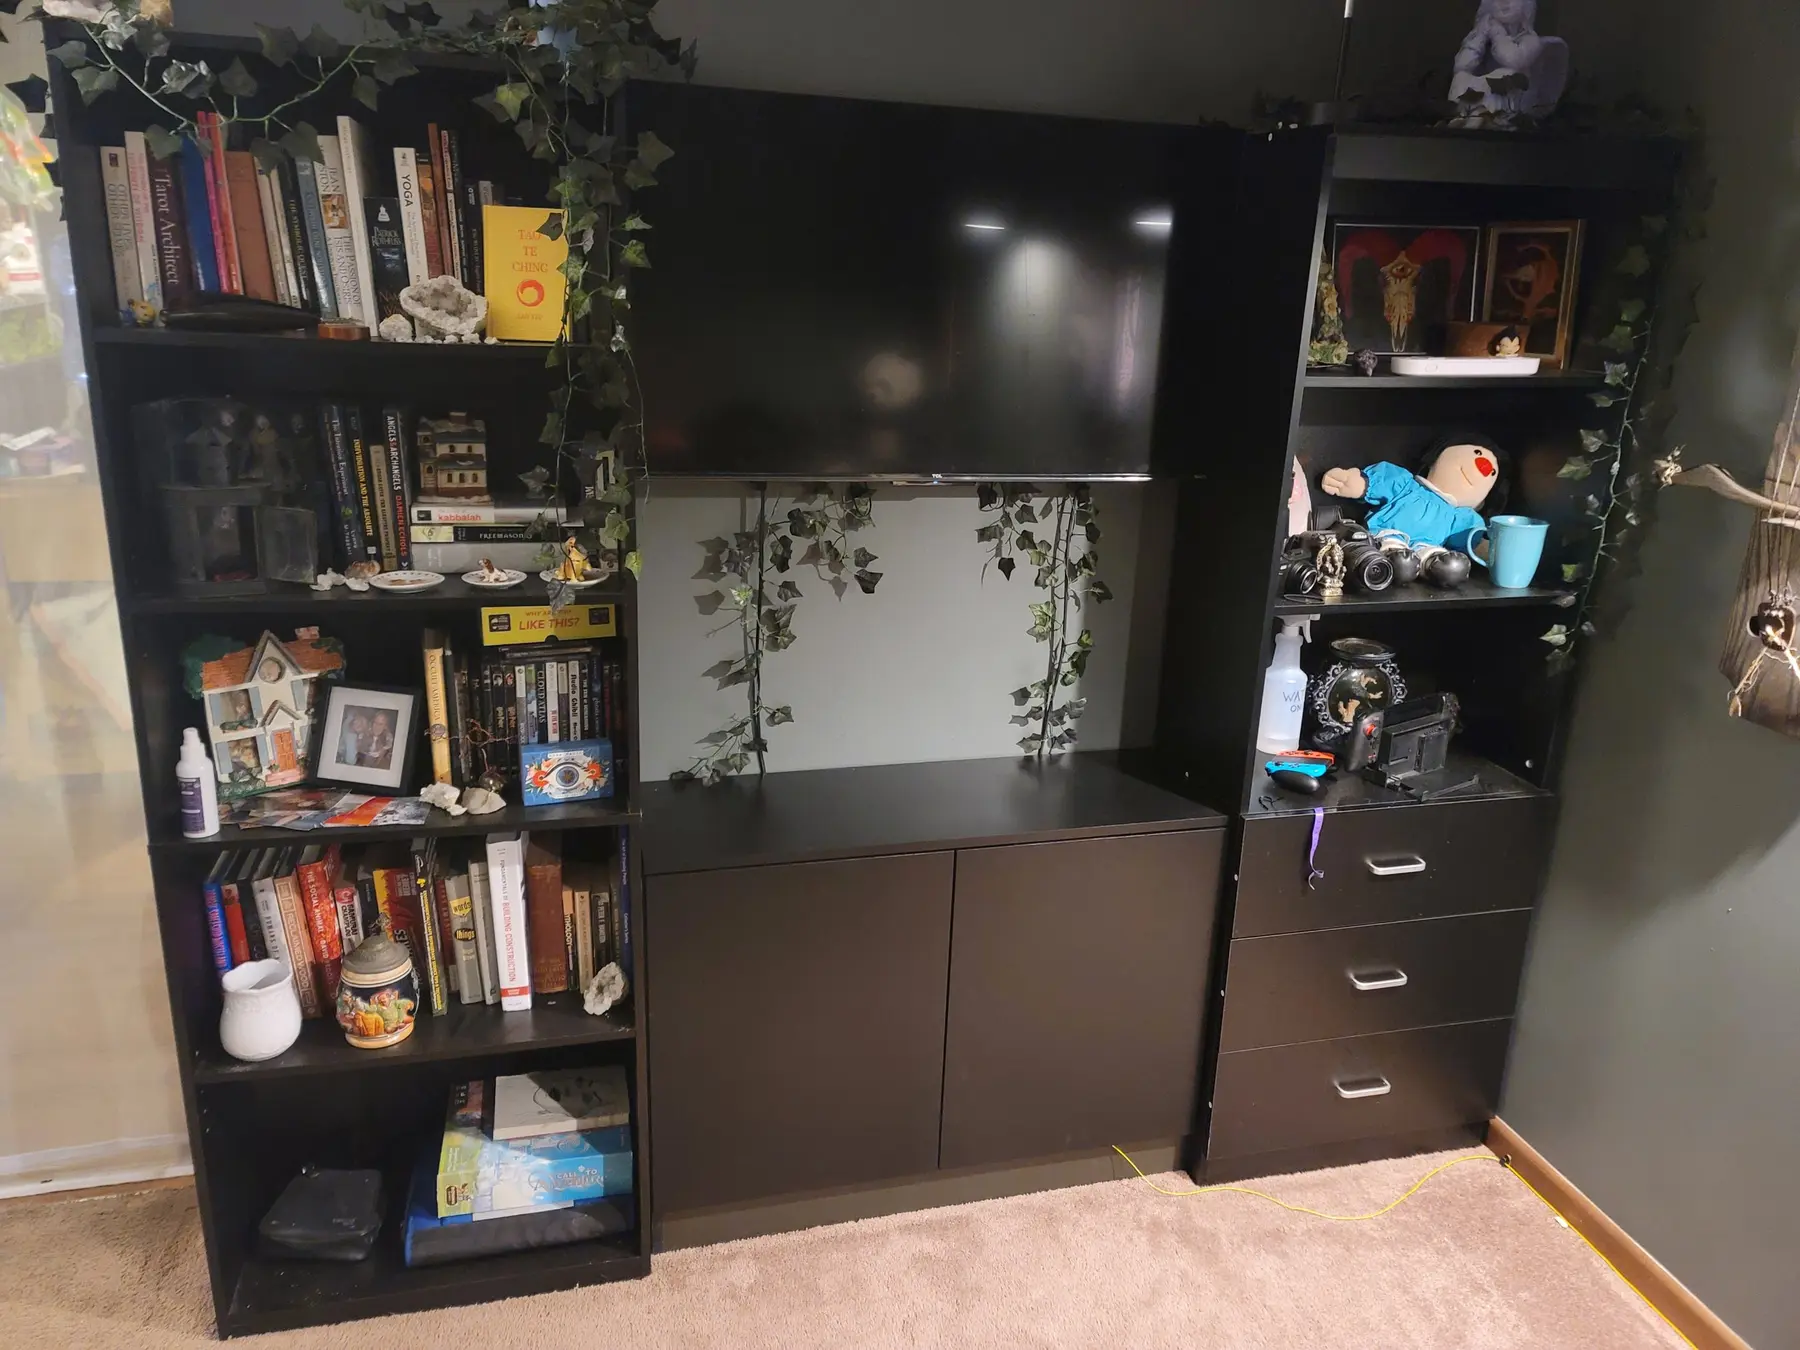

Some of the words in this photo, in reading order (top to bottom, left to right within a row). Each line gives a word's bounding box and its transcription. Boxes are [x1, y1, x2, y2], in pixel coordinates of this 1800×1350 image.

[328, 166, 340, 193] JEAN
[401, 174, 414, 207] YOGA
[153, 174, 174, 214] Tarot
[342, 234, 354, 252] THE
[517, 229, 541, 239] TAO
[159, 216, 183, 285] Architect
[522, 245, 537, 255] TE
[336, 254, 347, 274] AND
[345, 254, 360, 294] PASSION
[512, 261, 548, 272] CHING
[340, 275, 352, 304] OSIRIS
[351, 294, 361, 306] OF
[331, 417, 340, 431] The
[385, 415, 396, 442] ANGELS
[389, 446, 401, 490] ARCHANGELS
[359, 482, 367, 495] AND
[361, 495, 369, 507] THE
[362, 507, 373, 536] ABSOLUTE
[394, 495, 404, 526] DAMIEN
[438, 513, 481, 521] kabbalah
[398, 526, 407, 556] ECHOLS
[519, 620, 545, 631] LIKE
[549, 618, 581, 630] THIS?
[428, 654, 437, 685] OCCULT
[536, 670, 545, 699] CLOUD
[431, 686, 440, 721] AMERICA
[537, 699, 546, 723] ATLAS
[306, 870, 314, 883] THE
[308, 883, 319, 907] SOCIAL
[453, 900, 471, 912] words
[313, 907, 324, 933] ANIMAL
[347, 903, 357, 935] SAMURAI
[502, 901, 512, 931] BUILDING
[456, 927, 475, 939] things
[286, 912, 302, 960] RECLAIMED
[296, 959, 309, 988] WOOD
[319, 939, 329, 959] DAVID
[504, 933, 516, 982] CONSTRUCTION
[556, 1171, 577, 1179] CALL
